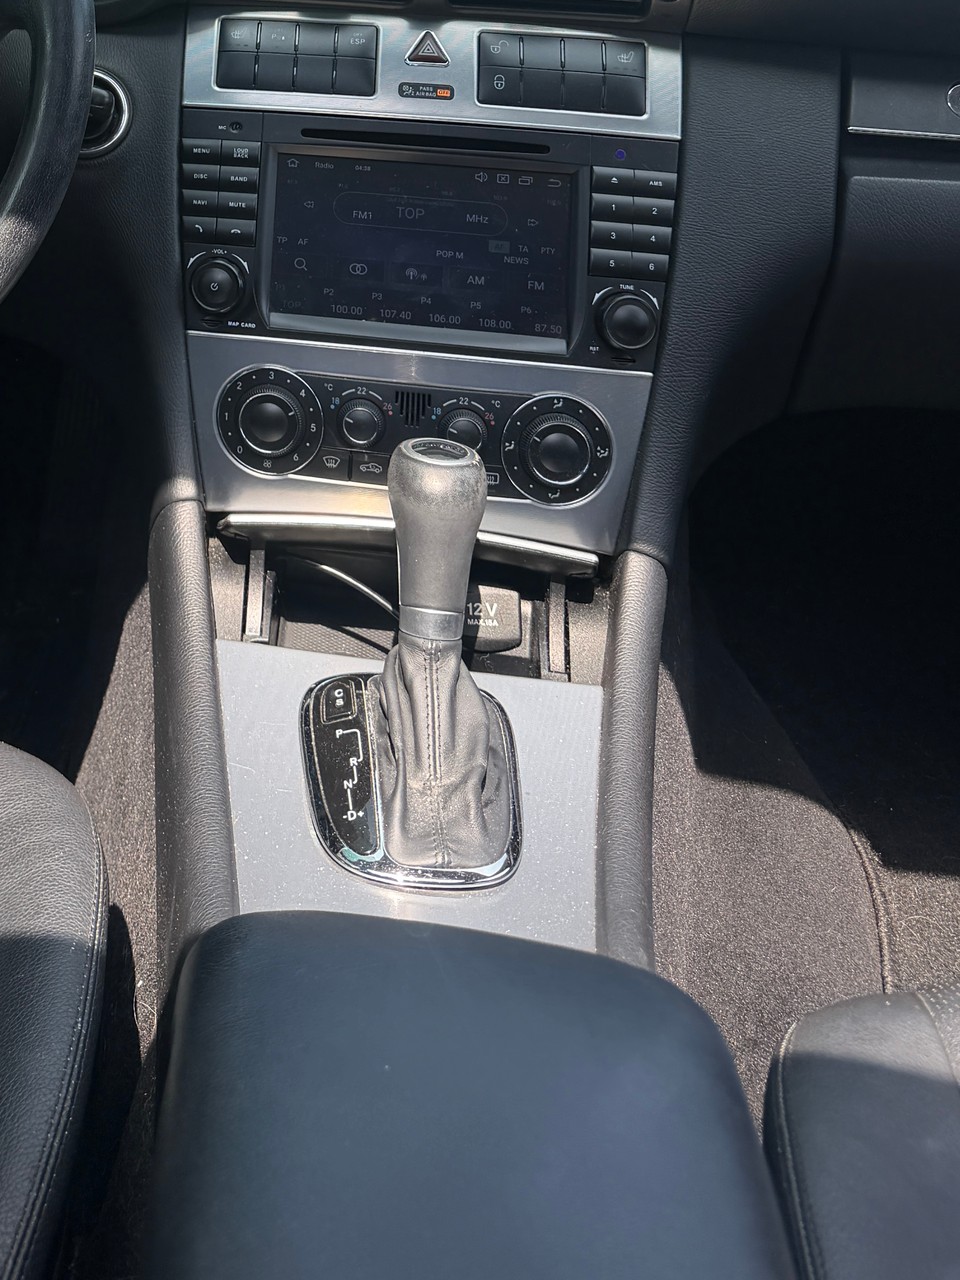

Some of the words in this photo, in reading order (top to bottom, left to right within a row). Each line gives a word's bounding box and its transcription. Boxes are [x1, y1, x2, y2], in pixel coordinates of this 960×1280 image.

[314, 162, 334, 170] Radio
[611, 204, 616, 212] 1
[652, 207, 658, 215] 2
[352, 210, 373, 221] FM1
[396, 206, 425, 220] TOP
[466, 213, 488, 224] MHz
[276, 236, 288, 244] TP
[297, 238, 309, 246] AF
[610, 232, 616, 240] 3
[650, 234, 656, 242] 4
[436, 250, 454, 259] POP
[456, 252, 464, 260] M
[518, 244, 529, 254] TA
[540, 246, 556, 256] PTY
[504, 256, 529, 266] NEWS
[609, 259, 616, 268] 5
[648, 262, 655, 270] 6
[466, 274, 485, 286] AM
[527, 280, 544, 291] FM
[323, 287, 334, 296] P2
[372, 292, 383, 301] P3
[420, 296, 432, 306] P4
[470, 300, 482, 310] P5
[520, 305, 532, 314] P6
[330, 304, 363, 316] 100.00
[379, 308, 412, 320] 107.40
[428, 312, 462, 324] 106.00
[478, 318, 511, 329] 108.00
[534, 322, 562, 335] 87.50
[268, 371, 275, 380] 3
[236, 381, 242, 390] 2
[299, 388, 306, 398] 4
[356, 387, 367, 395] 22
[331, 396, 340, 405] 18
[458, 396, 469, 406] 22
[382, 402, 393, 411] 26
[433, 407, 442, 415] 18
[484, 412, 494, 420] 26
[310, 423, 316, 432] 5
[236, 445, 243, 454] 0
[292, 452, 299, 462] 6
[466, 602, 483, 616] 12
[484, 602, 498, 618] V
[334, 688, 344, 698] C
[335, 728, 343, 739] P
[349, 757, 358, 767] R
[343, 778, 352, 790] N
